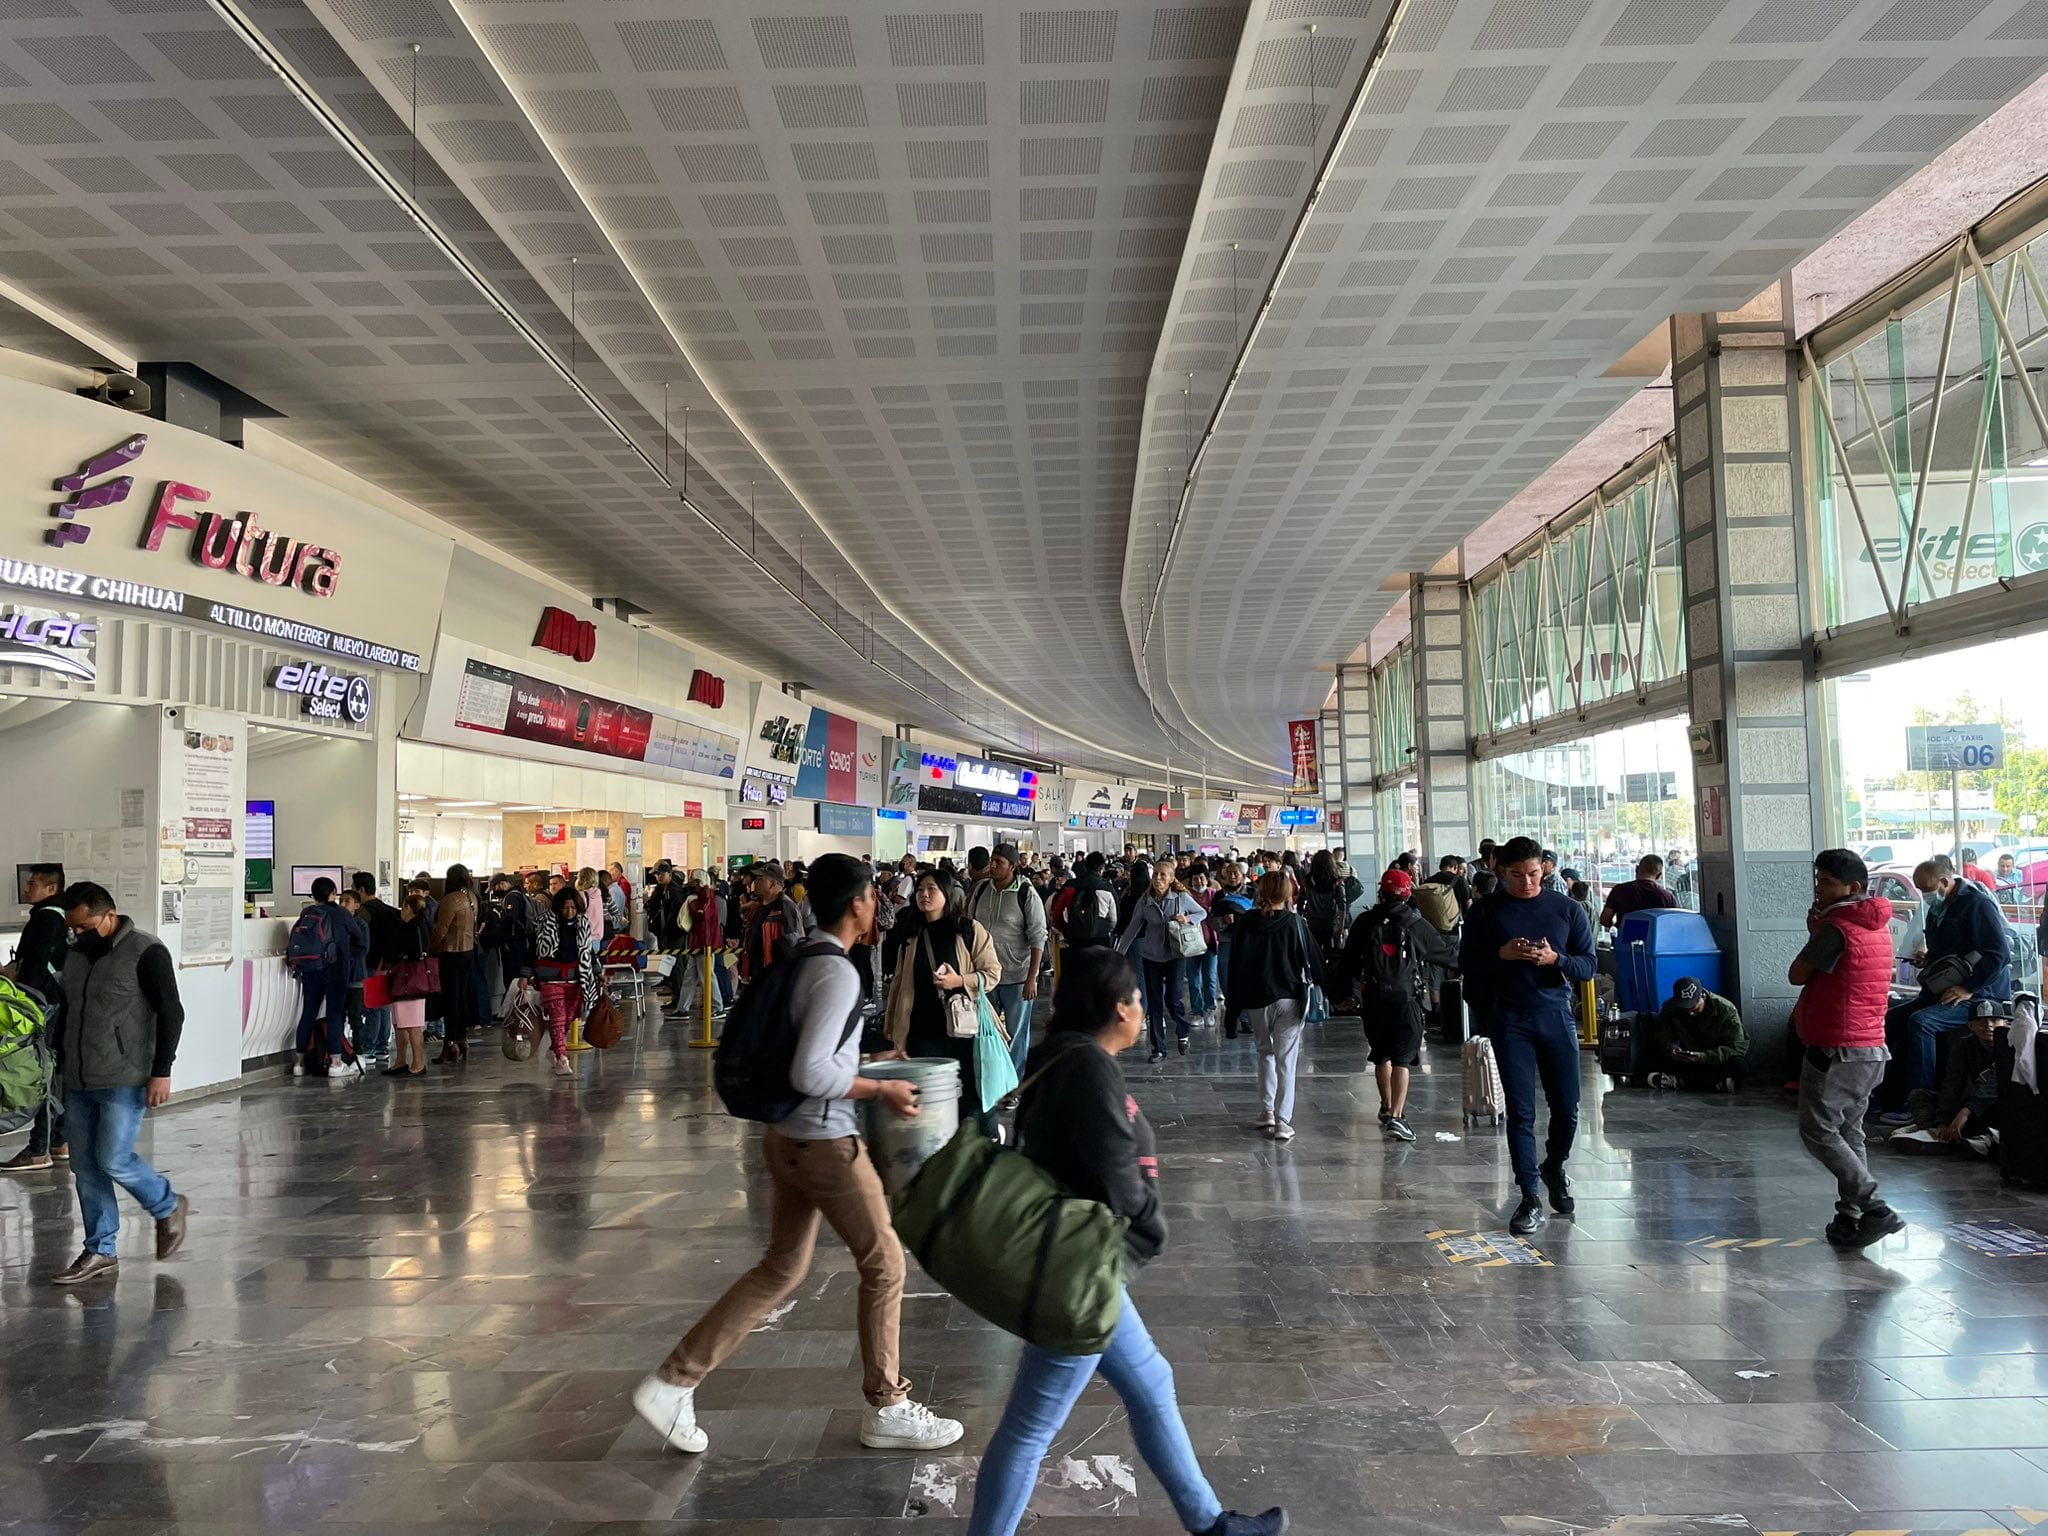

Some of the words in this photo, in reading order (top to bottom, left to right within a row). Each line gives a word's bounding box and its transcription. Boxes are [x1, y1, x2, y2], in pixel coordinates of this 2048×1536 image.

[139, 480, 343, 598] Futura
[0, 558, 87, 596] UAREZ
[264, 616, 330, 648] MONTERREY
[333, 634, 364, 657] NUEVO
[364, 643, 399, 666] LAREDO
[274, 661, 349, 701] elite
[309, 696, 341, 719] Select
[1963, 744, 1994, 767] 06
[1045, 803, 1058, 812] GATE
